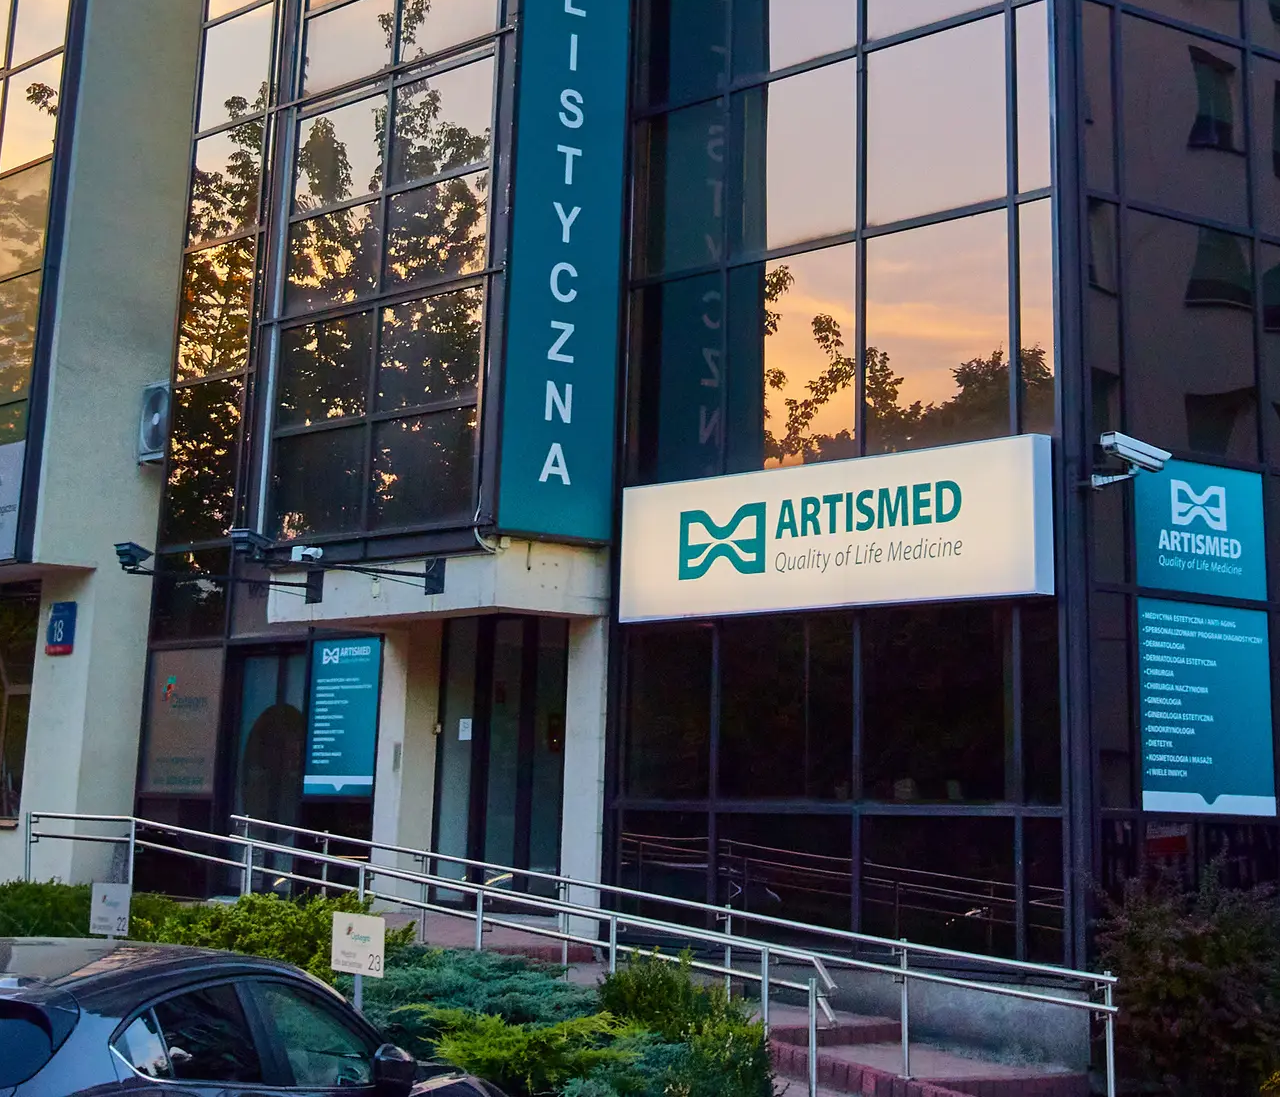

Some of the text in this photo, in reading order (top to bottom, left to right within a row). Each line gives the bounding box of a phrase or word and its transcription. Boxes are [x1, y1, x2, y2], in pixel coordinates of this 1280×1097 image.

[775, 479, 963, 540] ARTISMED
[1158, 529, 1242, 559] ARTISMED
[775, 536, 963, 574] Quality of Life Medicine
[1158, 555, 1243, 576] Quality of Life Medicine
[1145, 612, 1173, 622] MEDYCYNA
[1173, 614, 1204, 624] ESTETYCZNA
[53, 619, 64, 642] 18
[1145, 625, 1263, 645] SPERSONALIZOWANY PROGRAM DIAGNOSTYCZNY
[1146, 640, 1185, 650] DERMATOLOGIA
[1146, 654, 1217, 667] DERMATOLOGIA ESTETYCZNA
[1146, 668, 1175, 677] CHIRURGIA
[1146, 682, 1208, 694] CHIRURGIA NACZYNIOWA
[1147, 696, 1182, 706] GINEKOLOGIA
[1147, 710, 1214, 722] GINEKOLOGIA ESTETYCZNA
[1147, 725, 1196, 735] ENDOKRYNOLOGIA
[1149, 753, 1188, 763] KOSMETOLOGIA
[1152, 768, 1167, 776] WIELE
[1167, 769, 1188, 778] INNYCH
[116, 916, 127, 932] 22
[368, 953, 381, 972] 23
